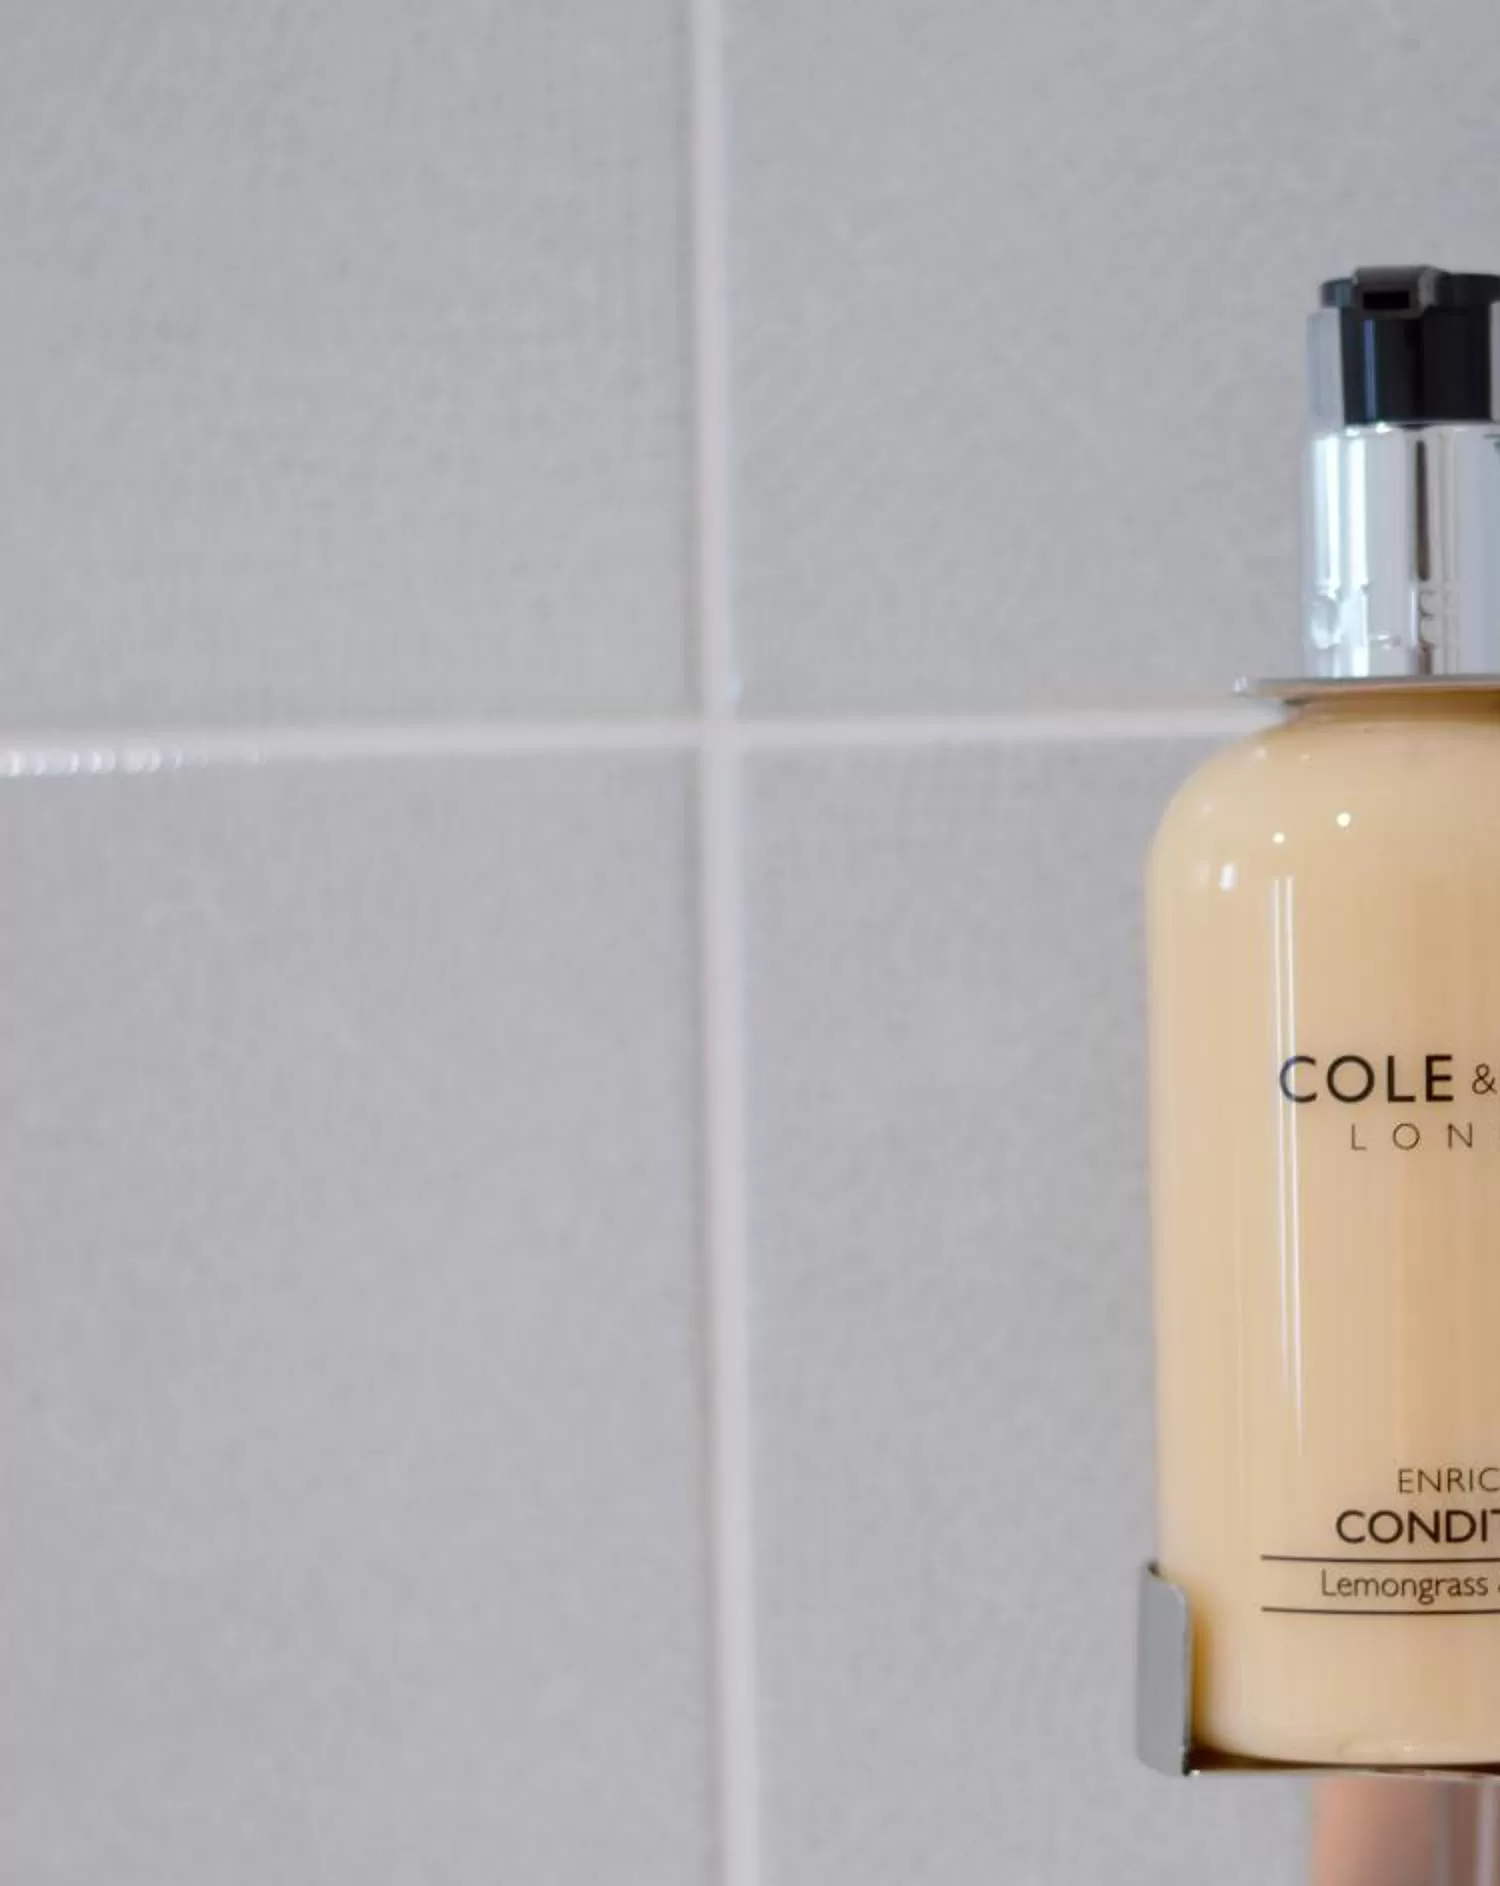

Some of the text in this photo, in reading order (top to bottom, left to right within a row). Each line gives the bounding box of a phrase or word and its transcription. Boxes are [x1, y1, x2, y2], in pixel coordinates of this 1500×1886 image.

[1279, 1054, 1455, 1103] COLE
[1471, 1062, 1498, 1095] &
[1320, 1568, 1490, 1606] Lemongrass
